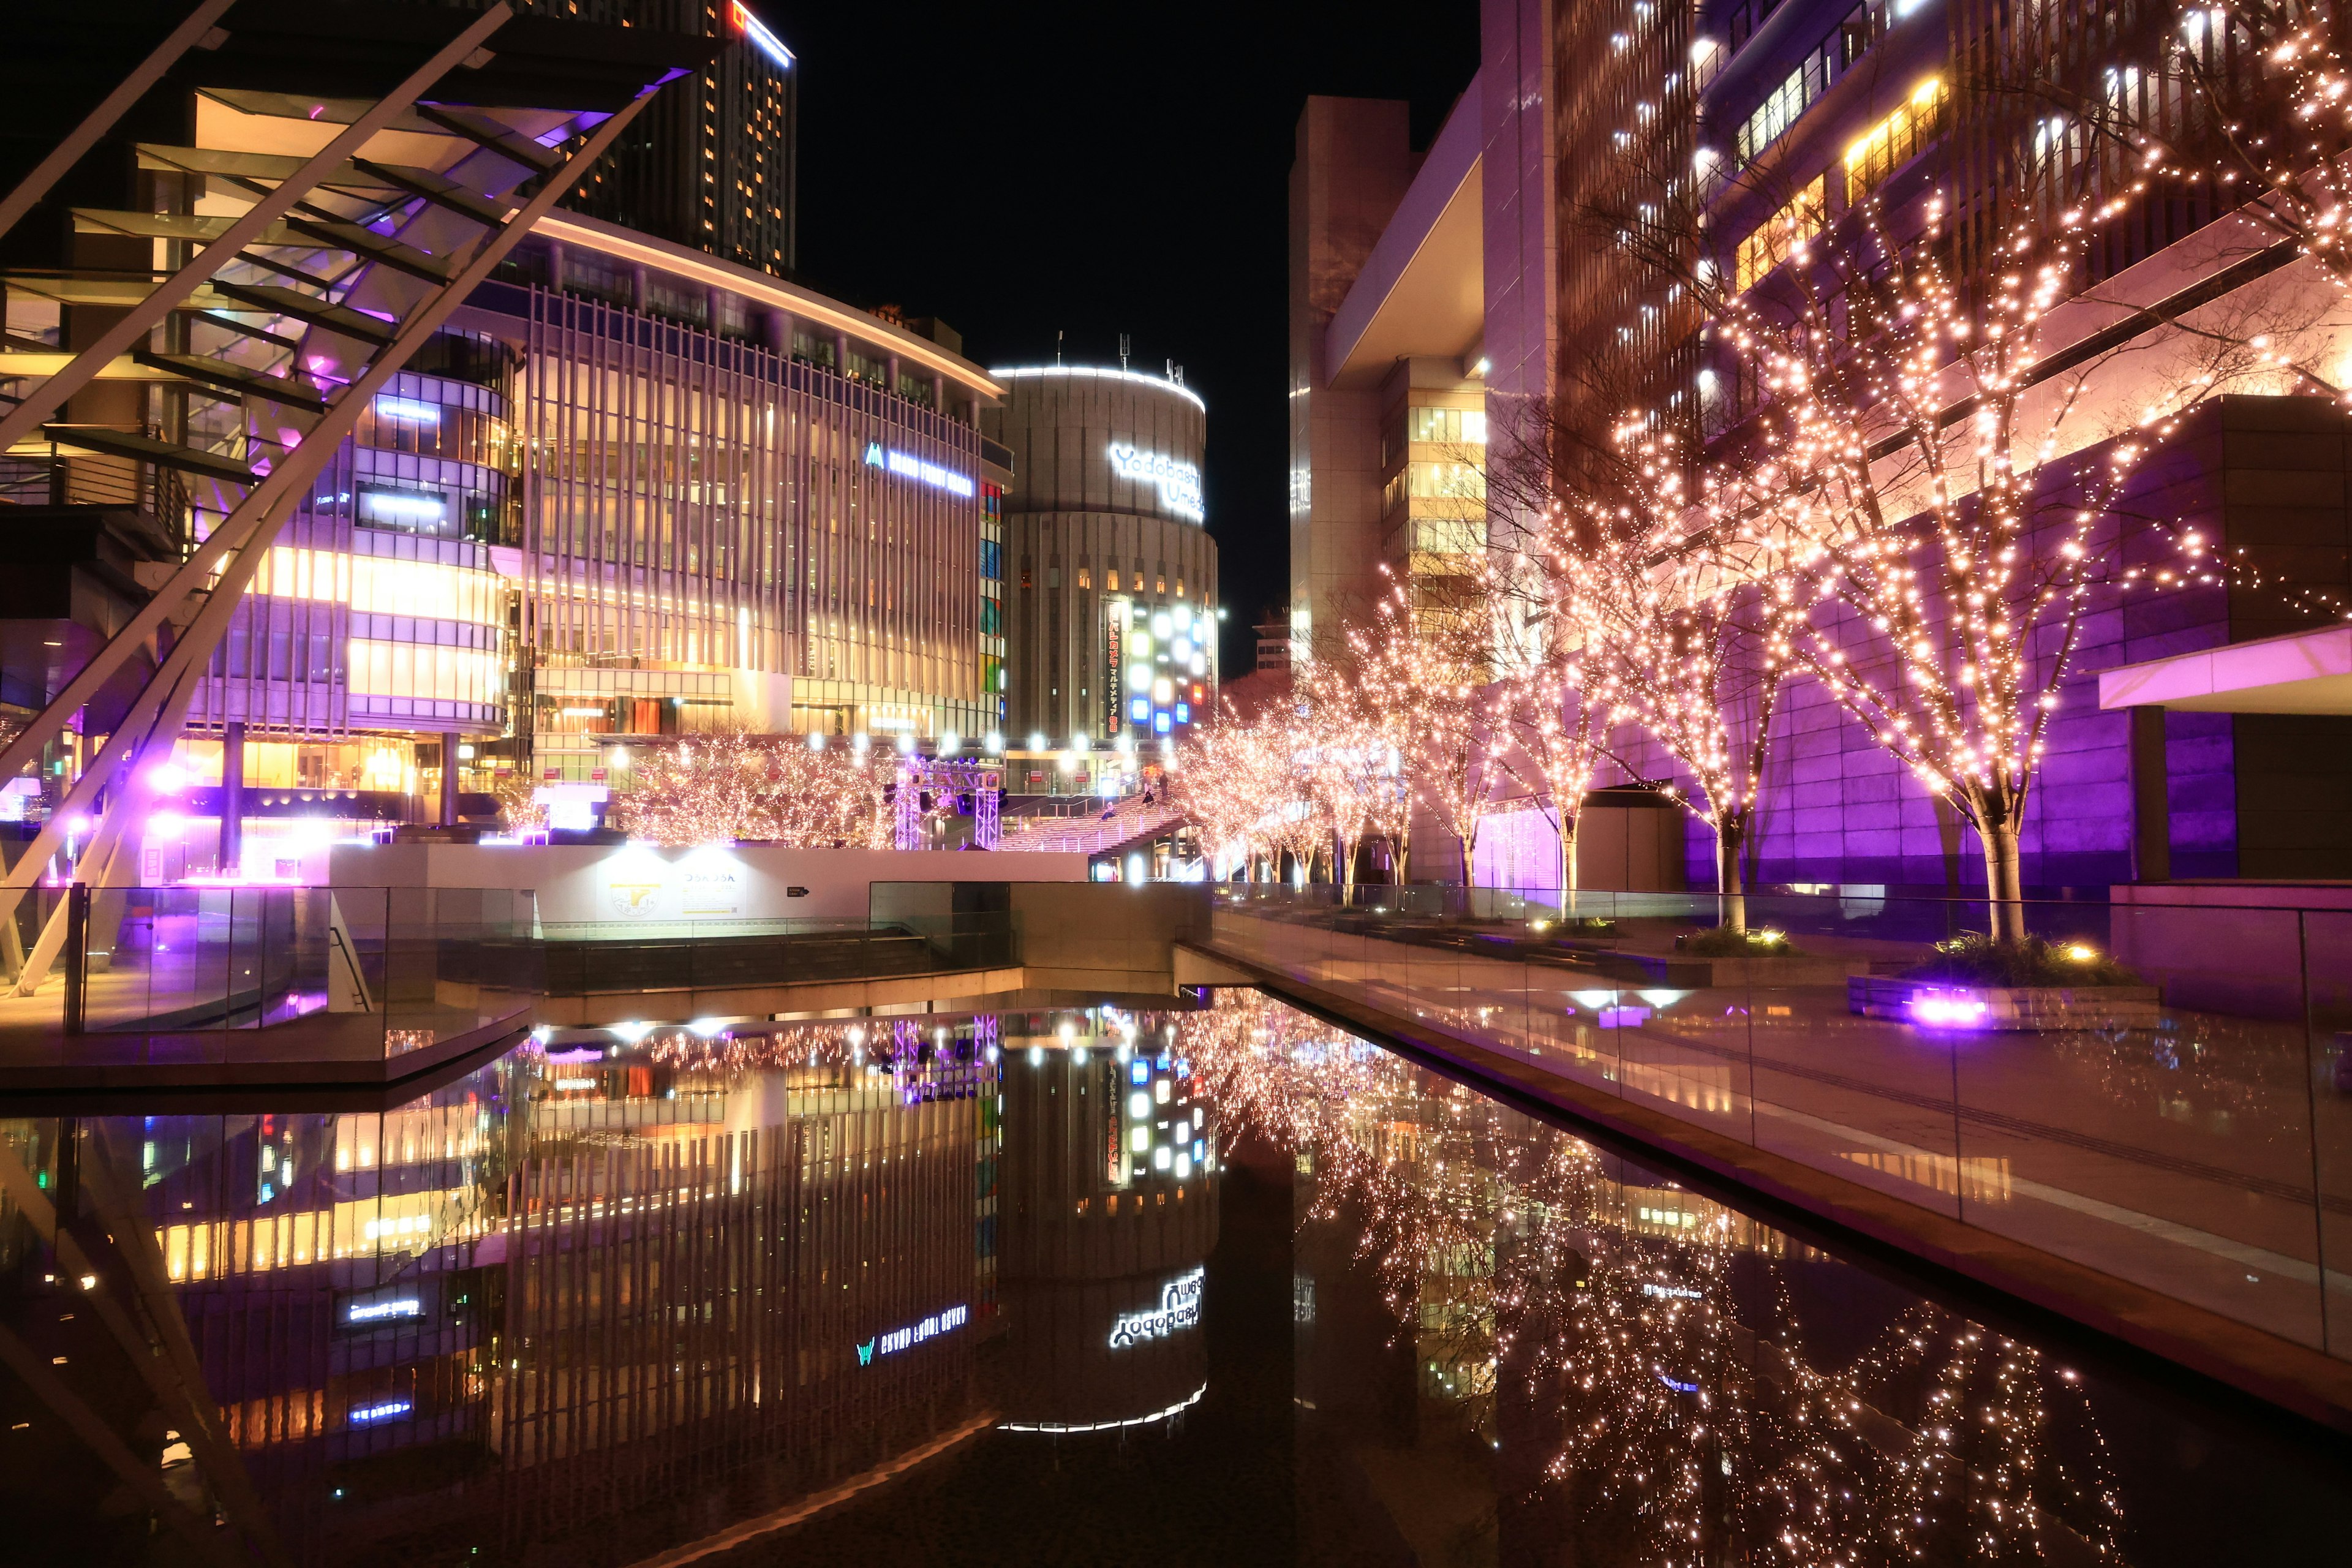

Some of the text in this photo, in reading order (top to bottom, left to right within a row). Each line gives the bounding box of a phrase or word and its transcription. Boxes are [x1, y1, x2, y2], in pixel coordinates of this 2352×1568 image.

[890, 452, 971, 497] GRAND FRONT OSAKA
[1115, 449, 1201, 492] Yodobashi
